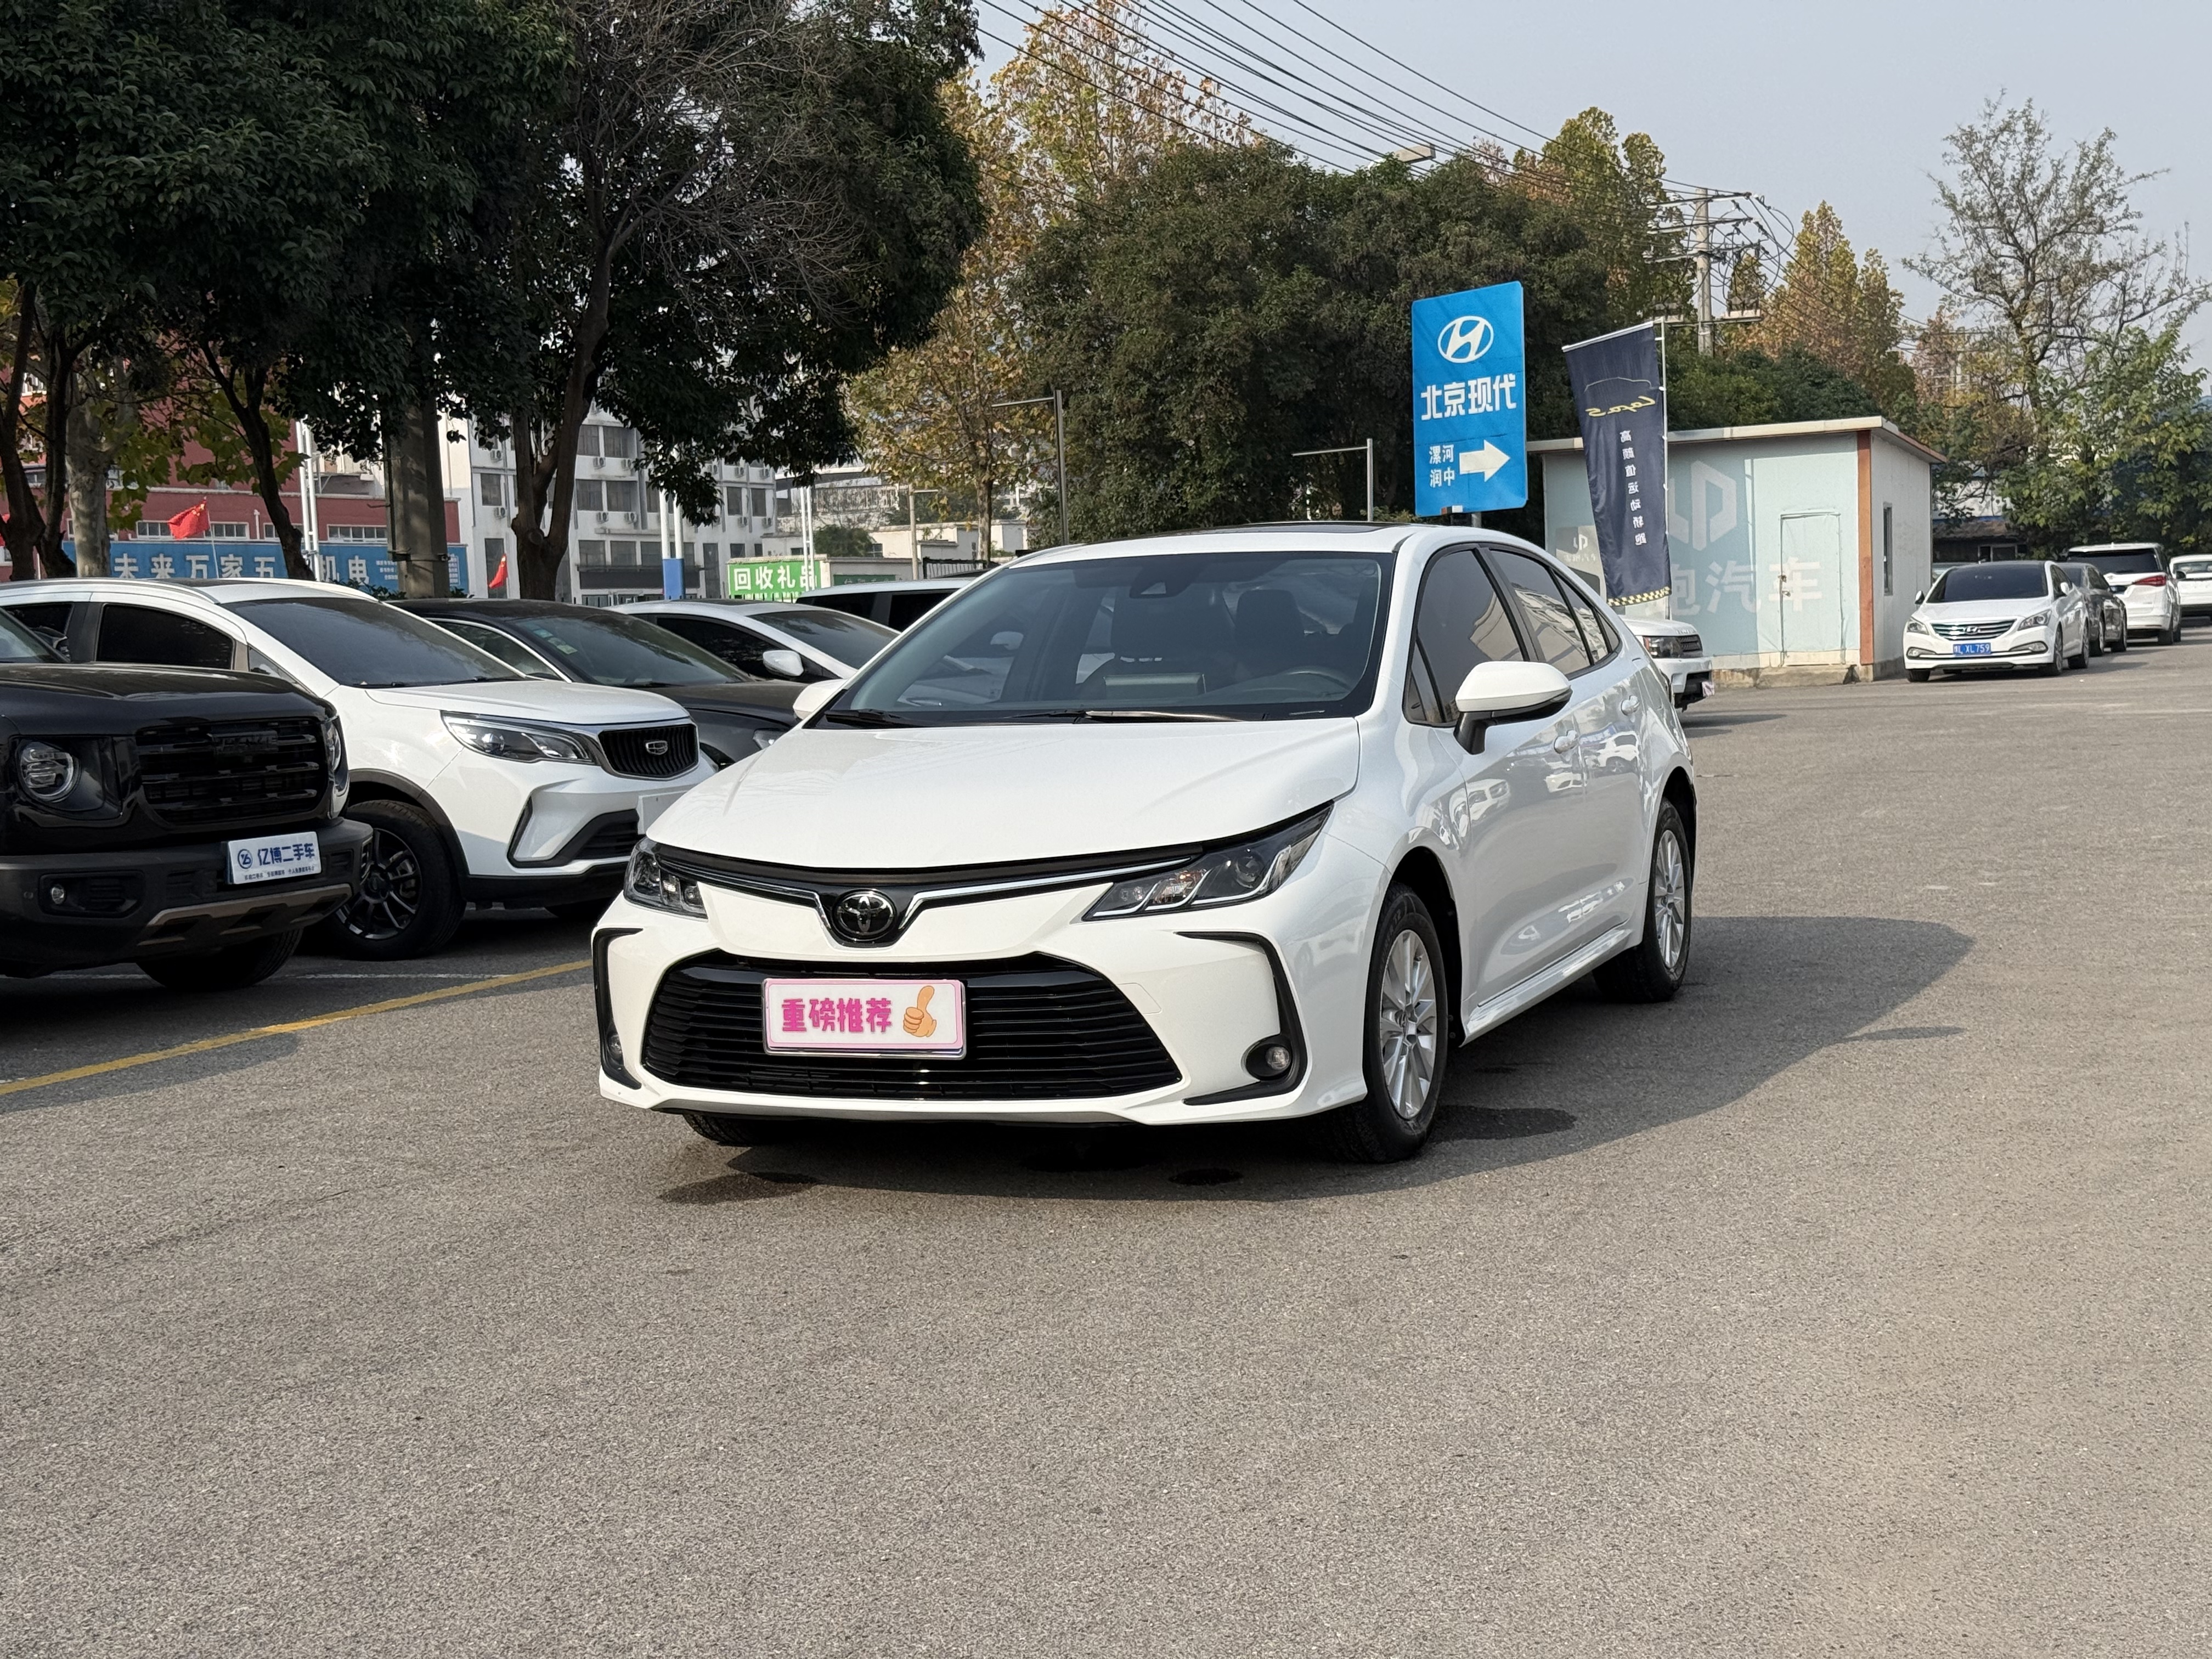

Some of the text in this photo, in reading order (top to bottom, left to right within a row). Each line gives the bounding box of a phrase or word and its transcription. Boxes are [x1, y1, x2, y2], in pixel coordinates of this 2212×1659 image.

[1420, 373, 1517, 420] 北京现代
[1429, 444, 1454, 465] 漯河
[1429, 467, 1455, 488] 润中
[114, 553, 369, 585] 未来万家五机电
[733, 565, 817, 591] 回收礼品
[258, 843, 315, 866] 亿博二手车
[781, 997, 893, 1034] 重磅推荐
